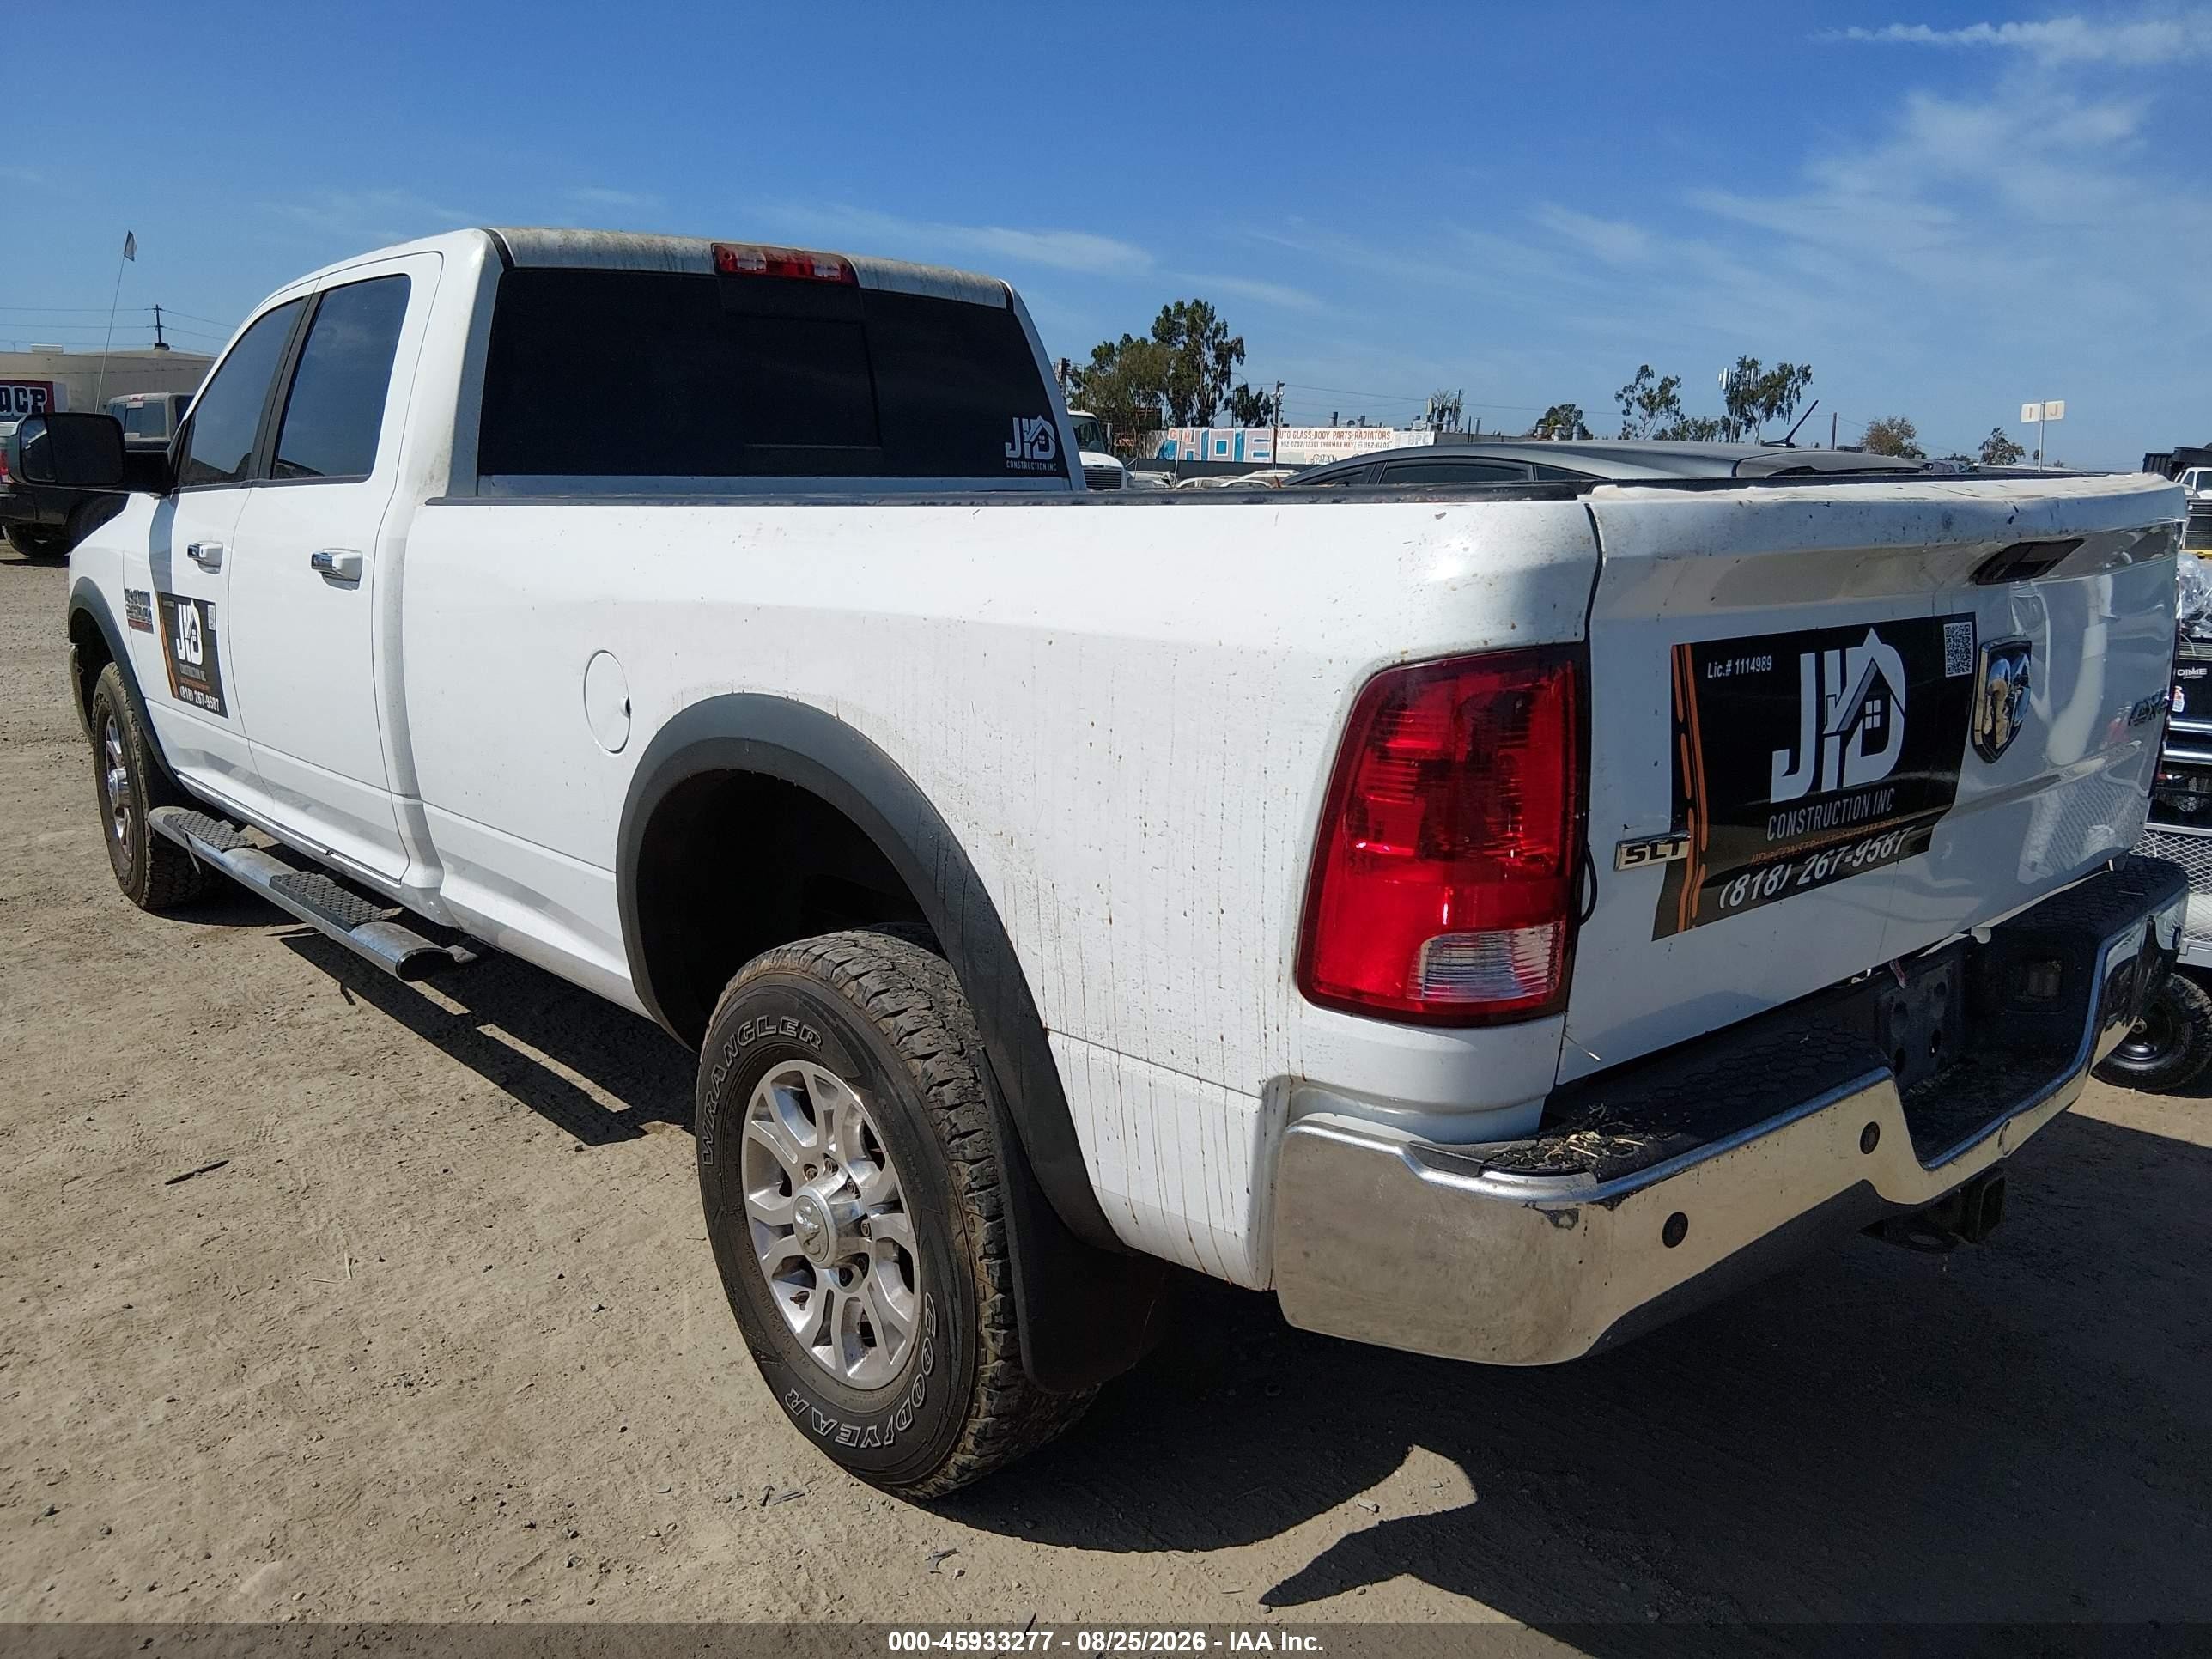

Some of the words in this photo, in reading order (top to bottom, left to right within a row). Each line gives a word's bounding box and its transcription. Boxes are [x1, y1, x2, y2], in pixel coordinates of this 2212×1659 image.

[2050, 404, 2058, 416] J
[1006, 459, 1047, 471] CONSTRUCTION
[1048, 463, 1057, 471] INC
[1707, 659, 1733, 678] Lic.#
[1735, 654, 1773, 676] 1114989
[1766, 796, 1869, 842] CONSTRUCTION
[1872, 787, 1896, 815] INC
[1624, 837, 1683, 866] SLT
[1719, 863, 1792, 909] (818)
[1796, 825, 1917, 886] 267-9587
[702, 1014, 823, 1166] WRANGLER
[783, 1291, 937, 1449] GOODYEAR
